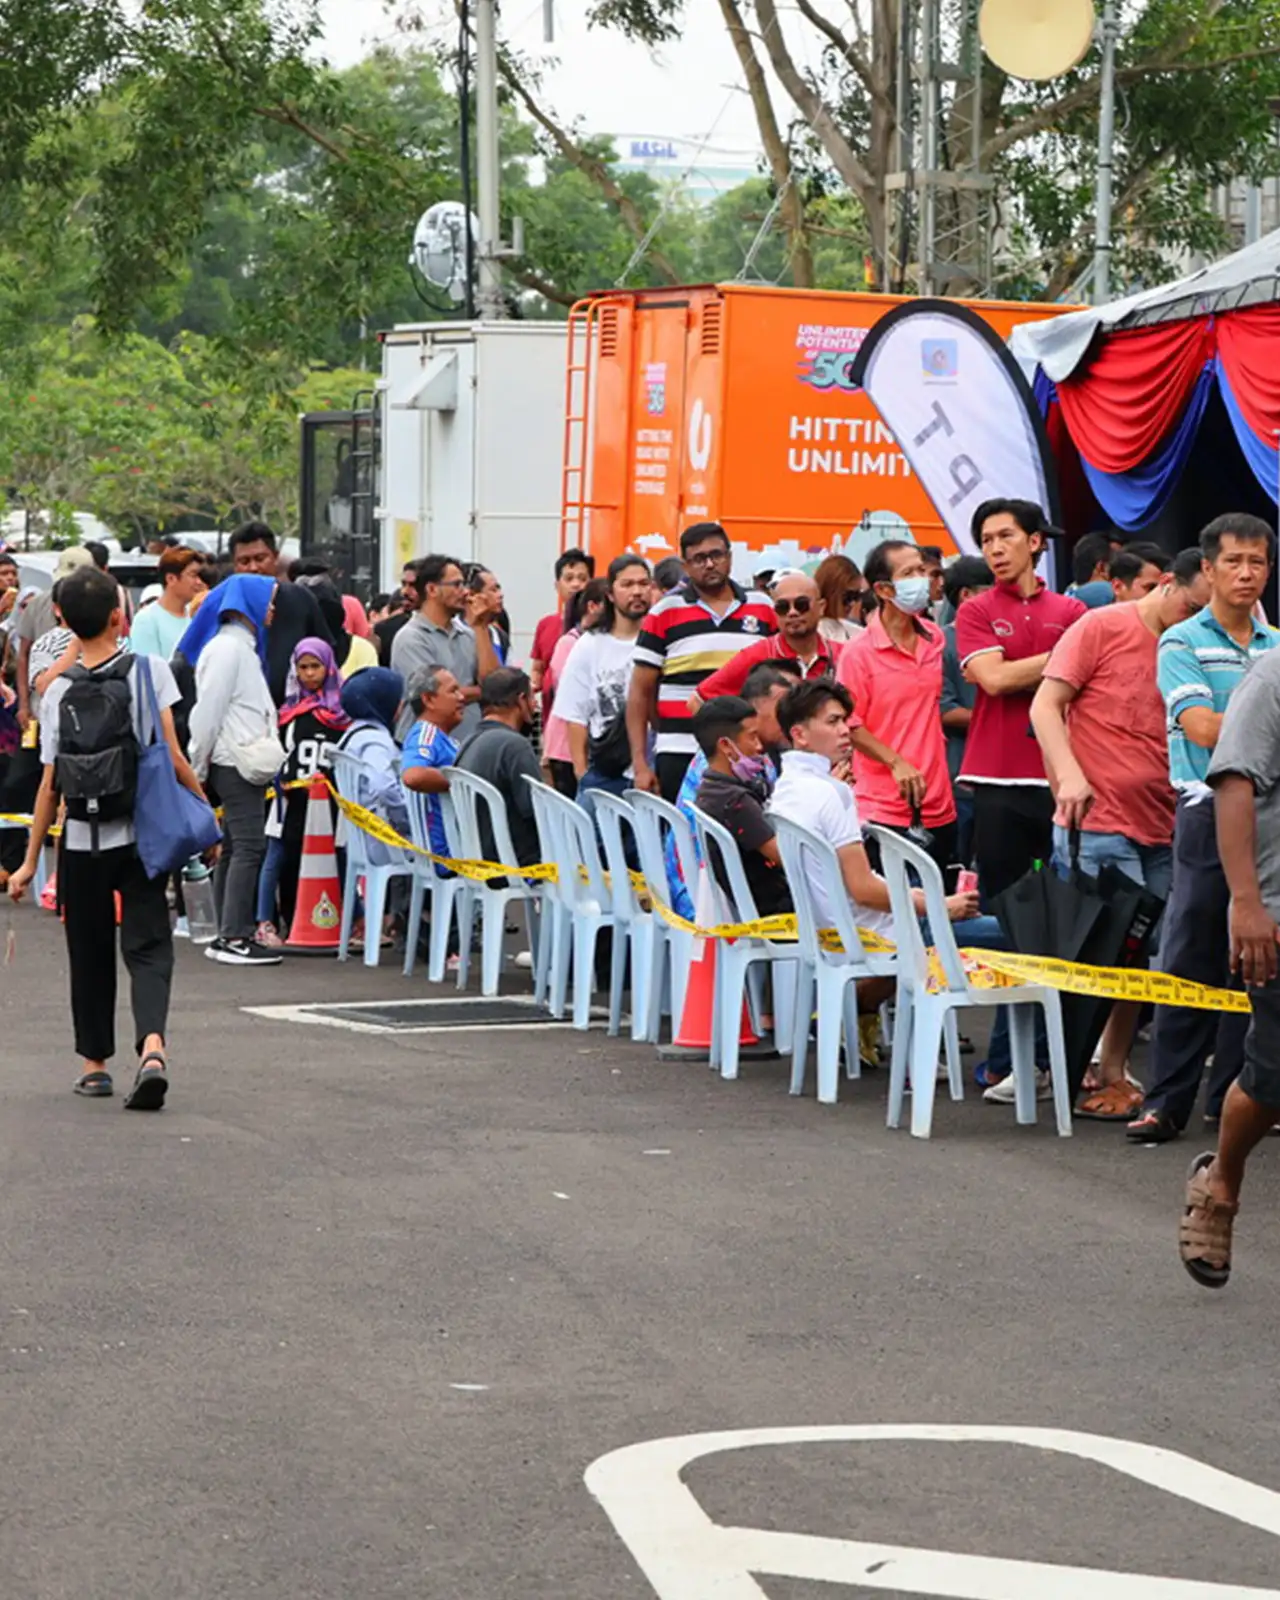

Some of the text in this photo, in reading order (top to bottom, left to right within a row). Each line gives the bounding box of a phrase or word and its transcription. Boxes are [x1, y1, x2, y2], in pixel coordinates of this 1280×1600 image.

[796, 336, 862, 350] POTENTIA
[789, 416, 894, 444] HITTIN
[788, 448, 911, 477] UNLIMIT
